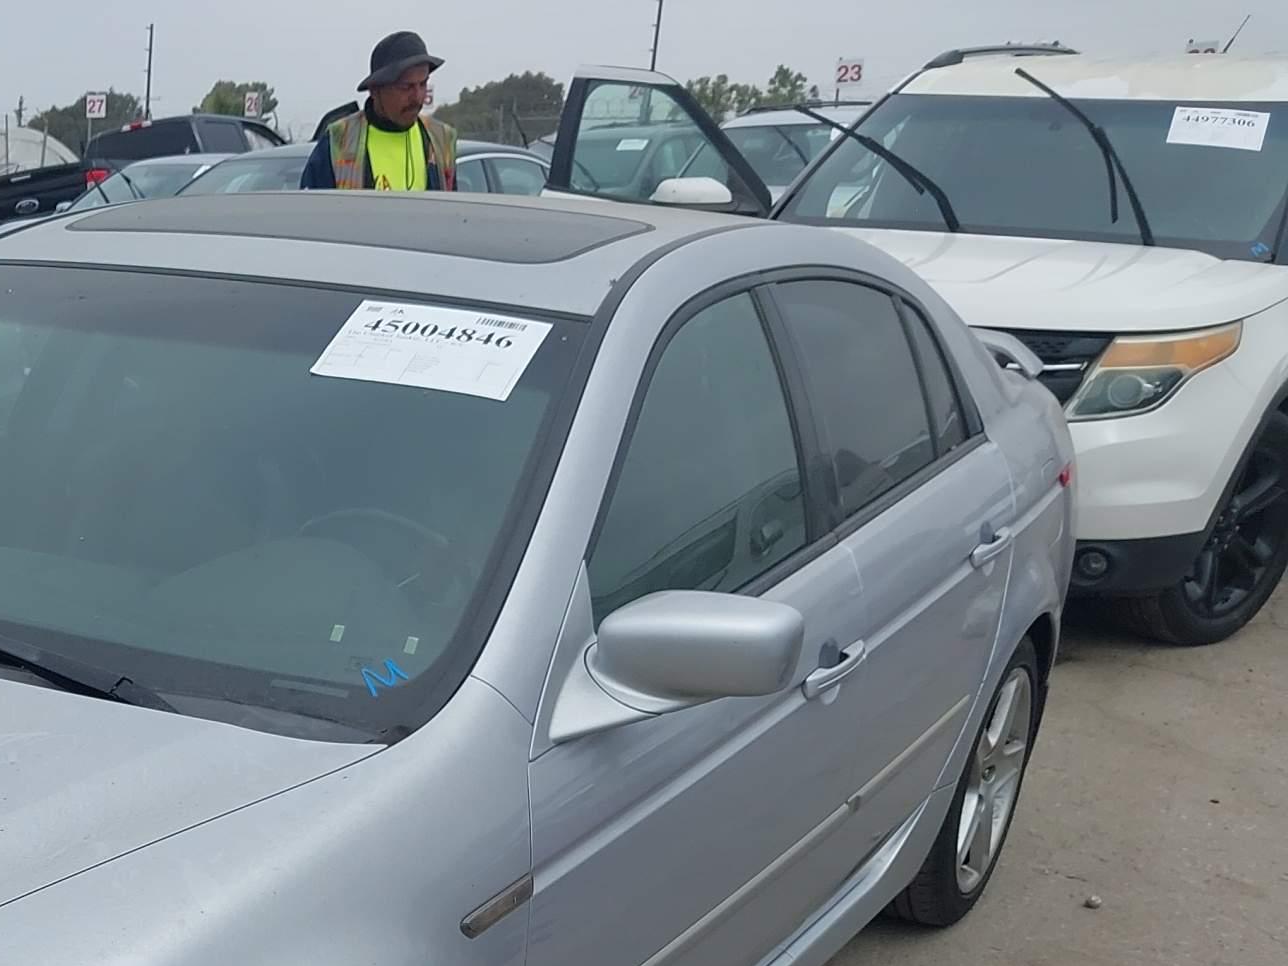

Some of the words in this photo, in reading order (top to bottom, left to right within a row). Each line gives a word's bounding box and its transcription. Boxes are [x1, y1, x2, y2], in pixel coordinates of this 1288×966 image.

[836, 64, 862, 83] 23
[87, 100, 104, 114] 27
[1182, 114, 1255, 127] 44977306
[364, 317, 514, 350] 45004846
